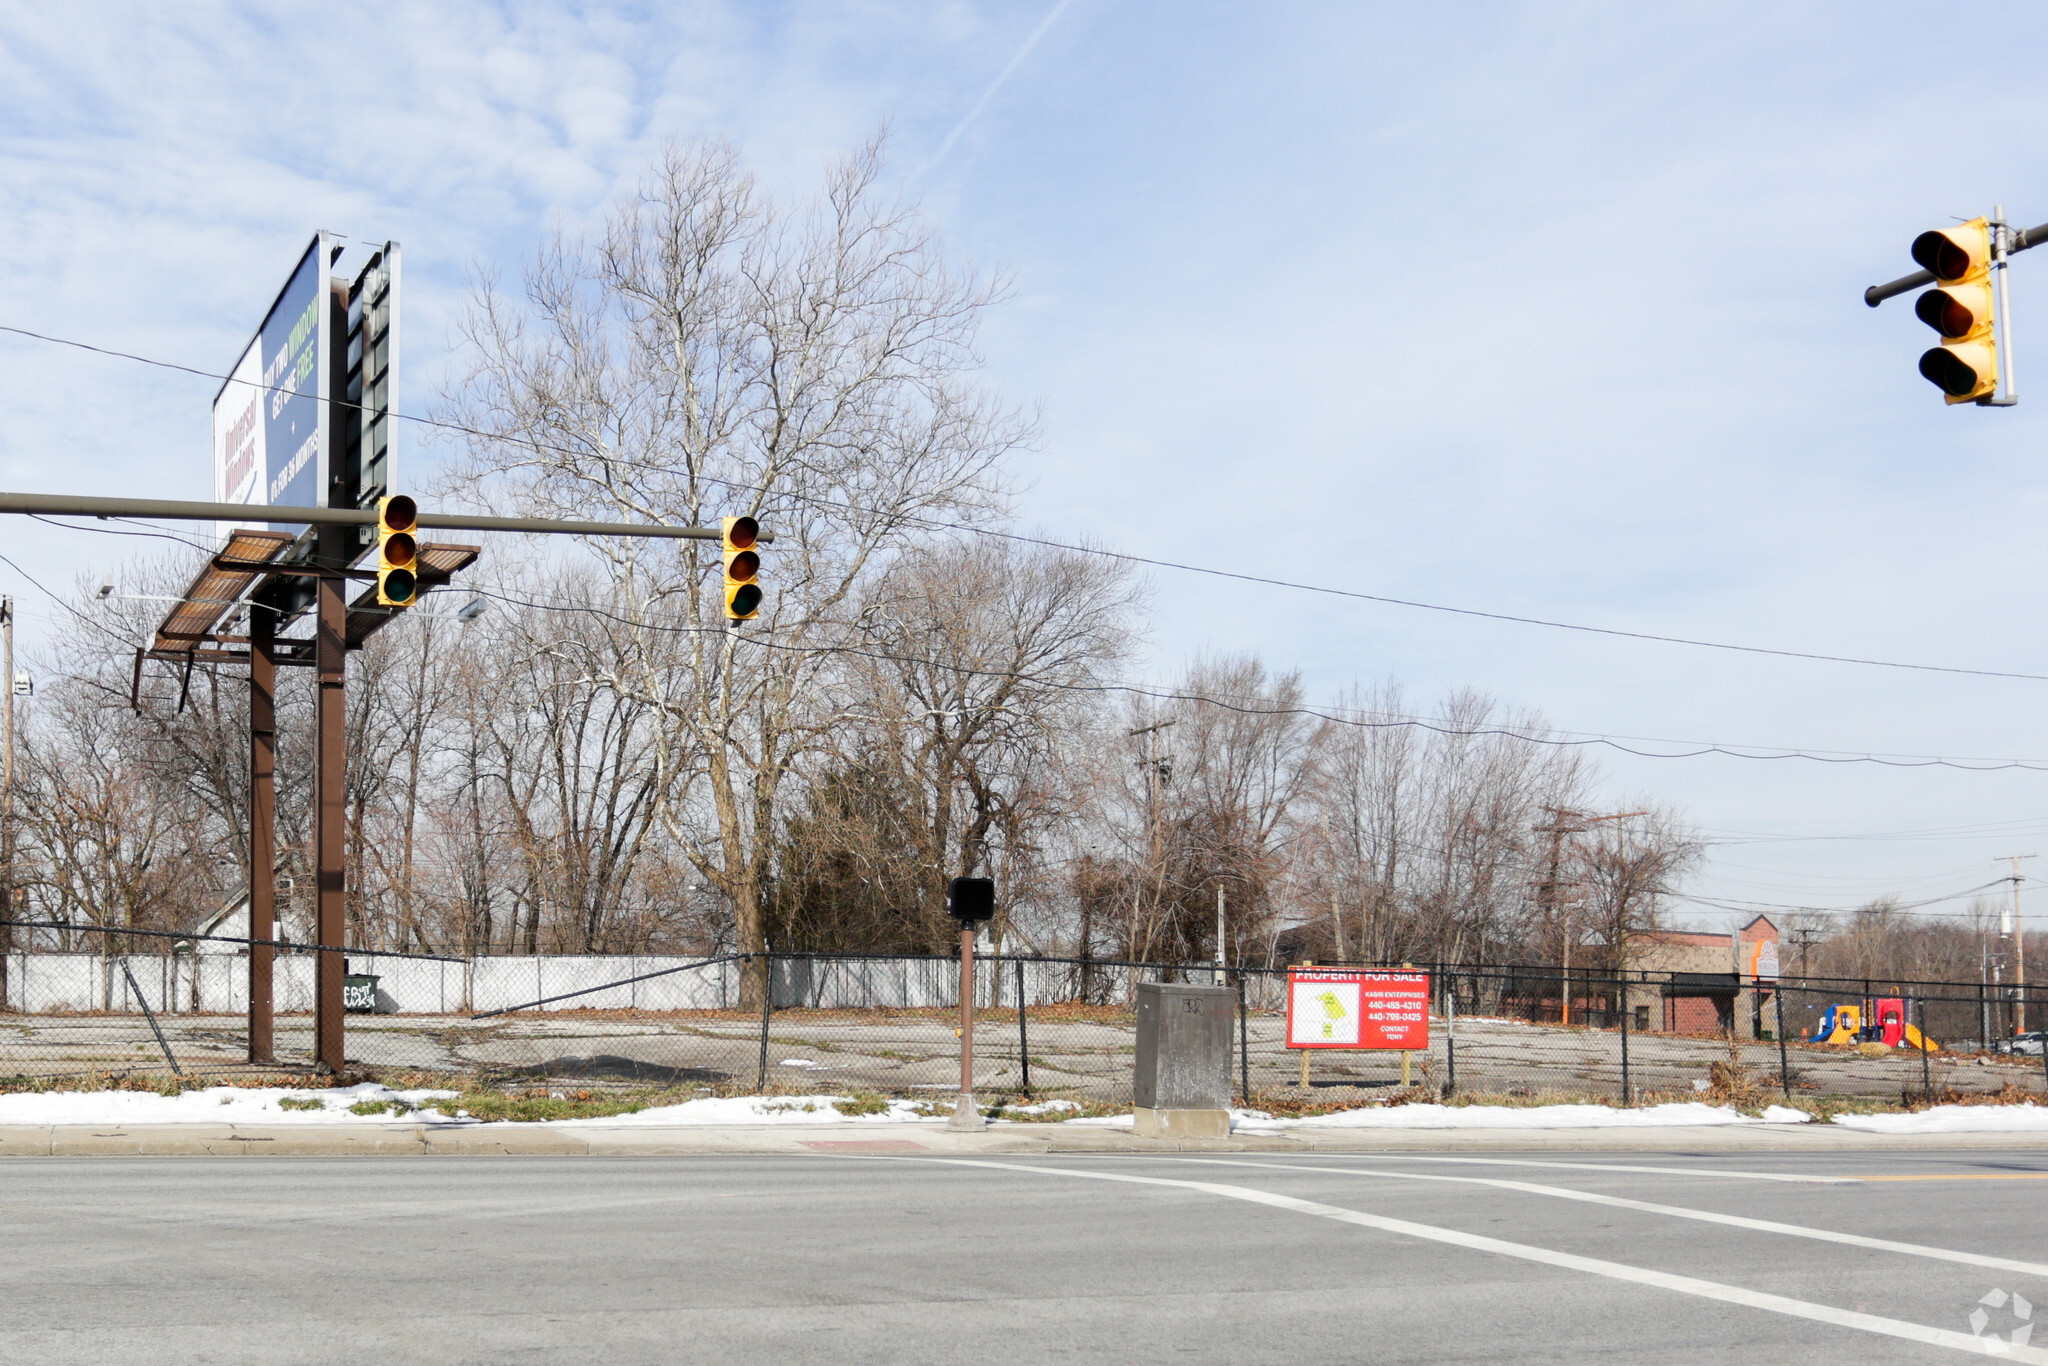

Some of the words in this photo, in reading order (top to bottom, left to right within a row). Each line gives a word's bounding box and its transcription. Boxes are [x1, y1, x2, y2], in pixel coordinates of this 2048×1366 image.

[264, 361, 275, 397] BUY
[276, 343, 288, 379] TWO
[273, 385, 283, 420] GET
[284, 368, 296, 405] ONE
[296, 339, 314, 389] FREE
[226, 388, 256, 467] Universal
[295, 428, 318, 475] MONTHS
[1295, 968, 1360, 980] PROPERTY
[1365, 970, 1389, 981] FOR
[1392, 970, 1424, 982] SALE
